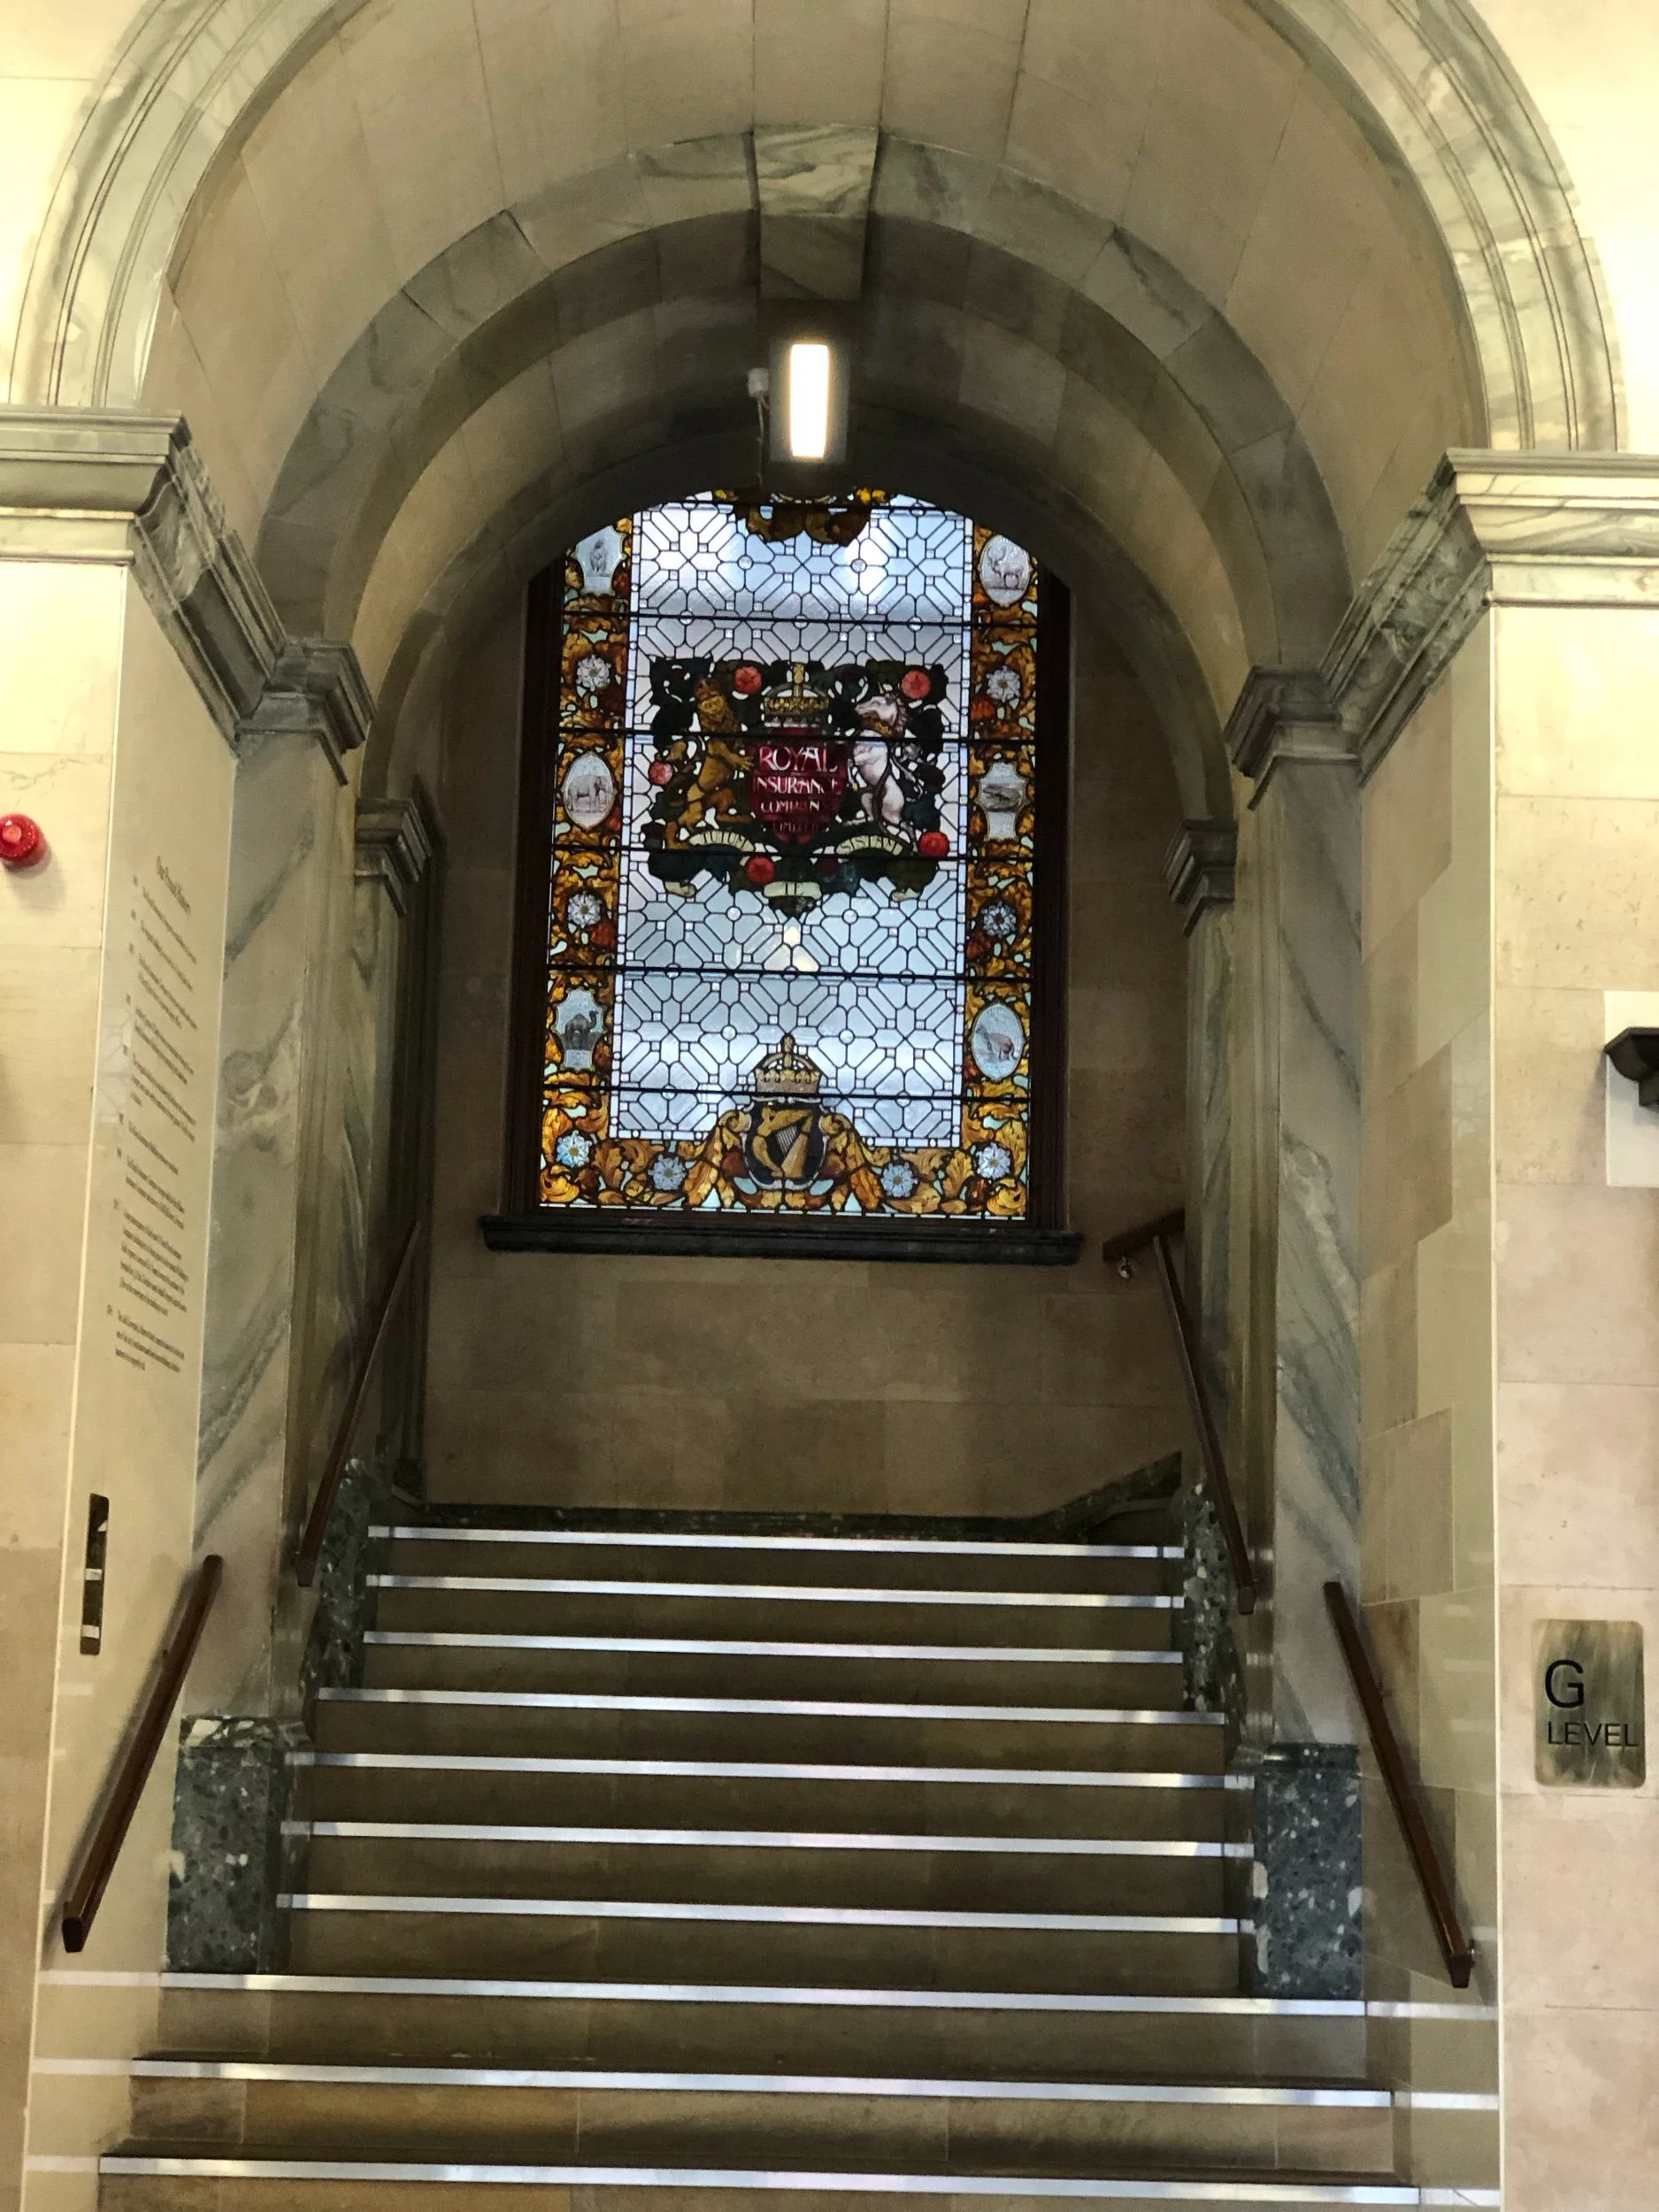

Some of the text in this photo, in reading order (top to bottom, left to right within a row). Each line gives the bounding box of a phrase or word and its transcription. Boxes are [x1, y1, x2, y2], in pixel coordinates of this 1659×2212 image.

[759, 746, 838, 772] ROYAL
[753, 776, 842, 795] INSURANE
[1545, 1659, 1585, 1709] G
[1548, 1721, 1640, 1747] LEVEL
